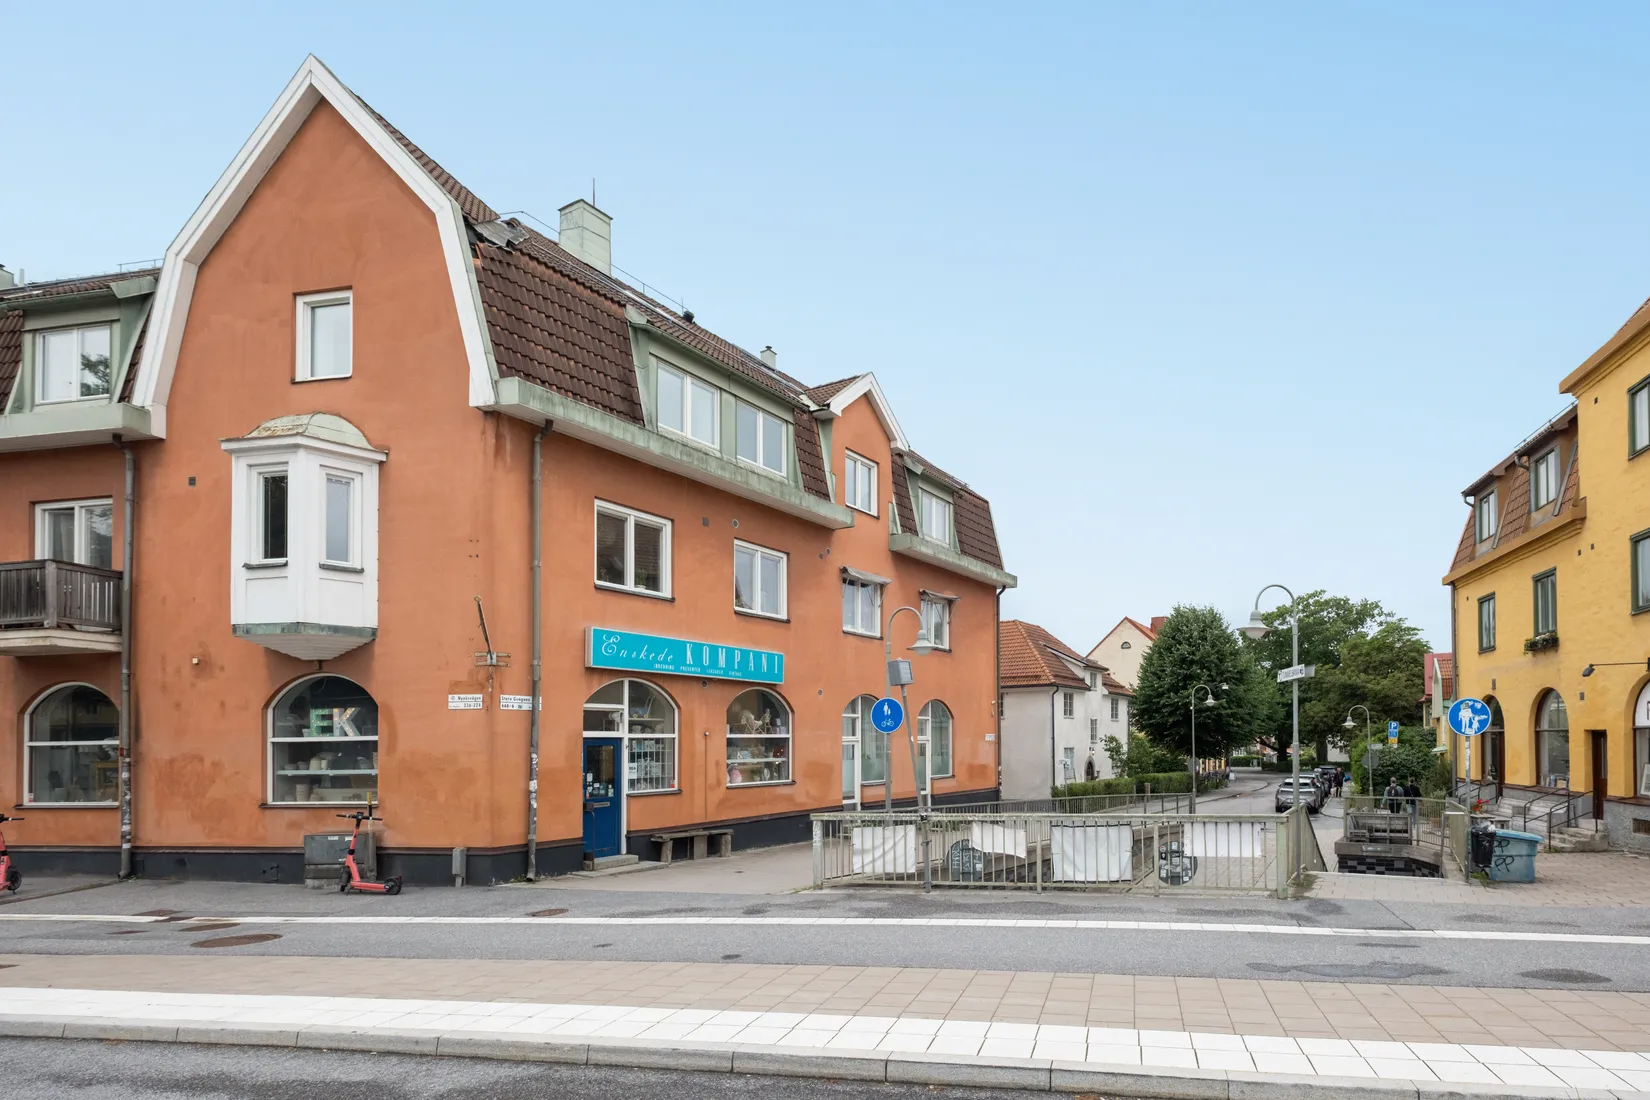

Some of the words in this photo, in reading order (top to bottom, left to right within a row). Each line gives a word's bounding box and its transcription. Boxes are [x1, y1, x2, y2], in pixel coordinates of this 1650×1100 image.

[602, 634, 673, 662] Enskede
[686, 644, 778, 674] KOMPANI
[310, 707, 361, 737] EK
